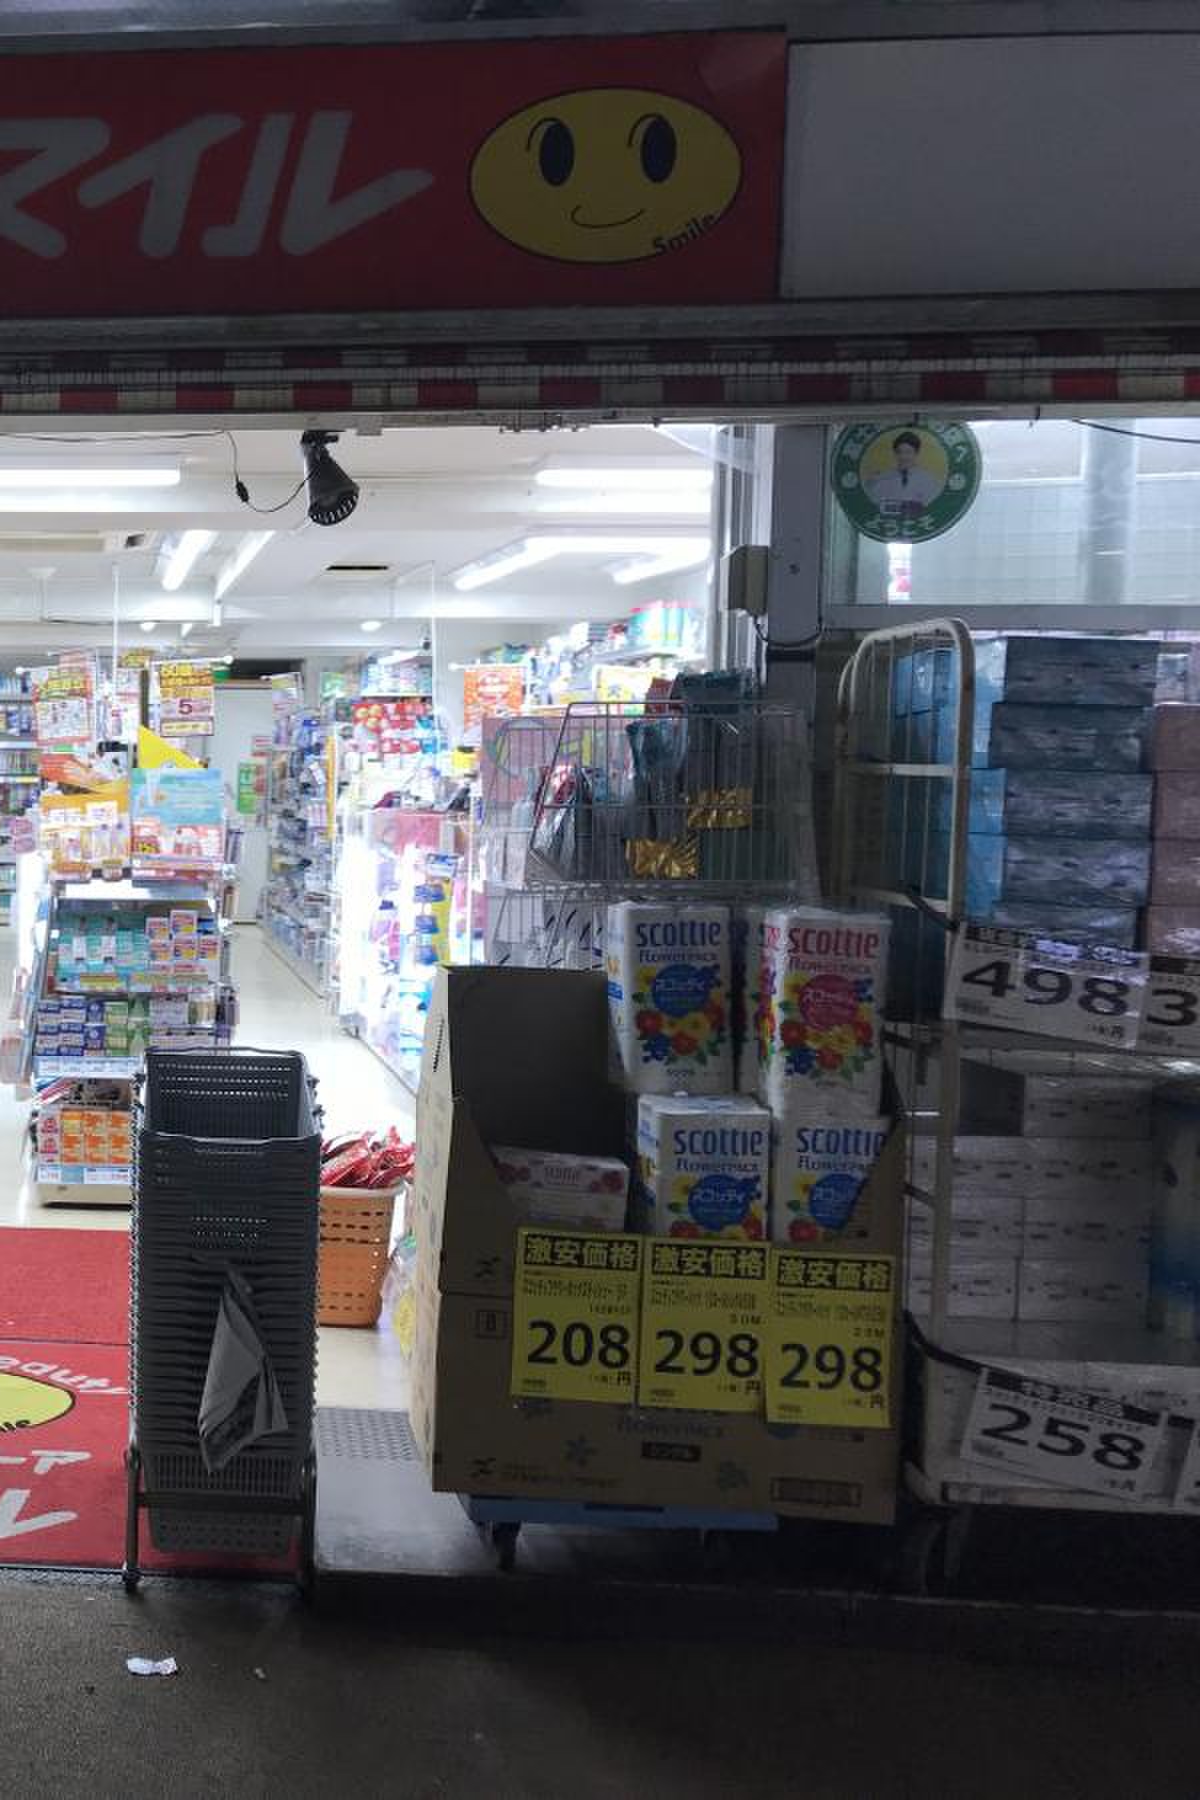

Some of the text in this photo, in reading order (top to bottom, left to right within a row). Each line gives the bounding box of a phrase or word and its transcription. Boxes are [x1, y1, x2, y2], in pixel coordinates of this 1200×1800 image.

[651, 214, 720, 256] Smile
[962, 961, 1130, 1016] 498
[526, 1239, 637, 1270] 激安価格
[653, 1245, 766, 1277] 激安価格
[779, 1258, 890, 1290] 激安価格
[528, 1320, 630, 1368] 208
[654, 1330, 758, 1378] 298
[780, 1344, 882, 1392] 298
[981, 1403, 1144, 1471] 258
